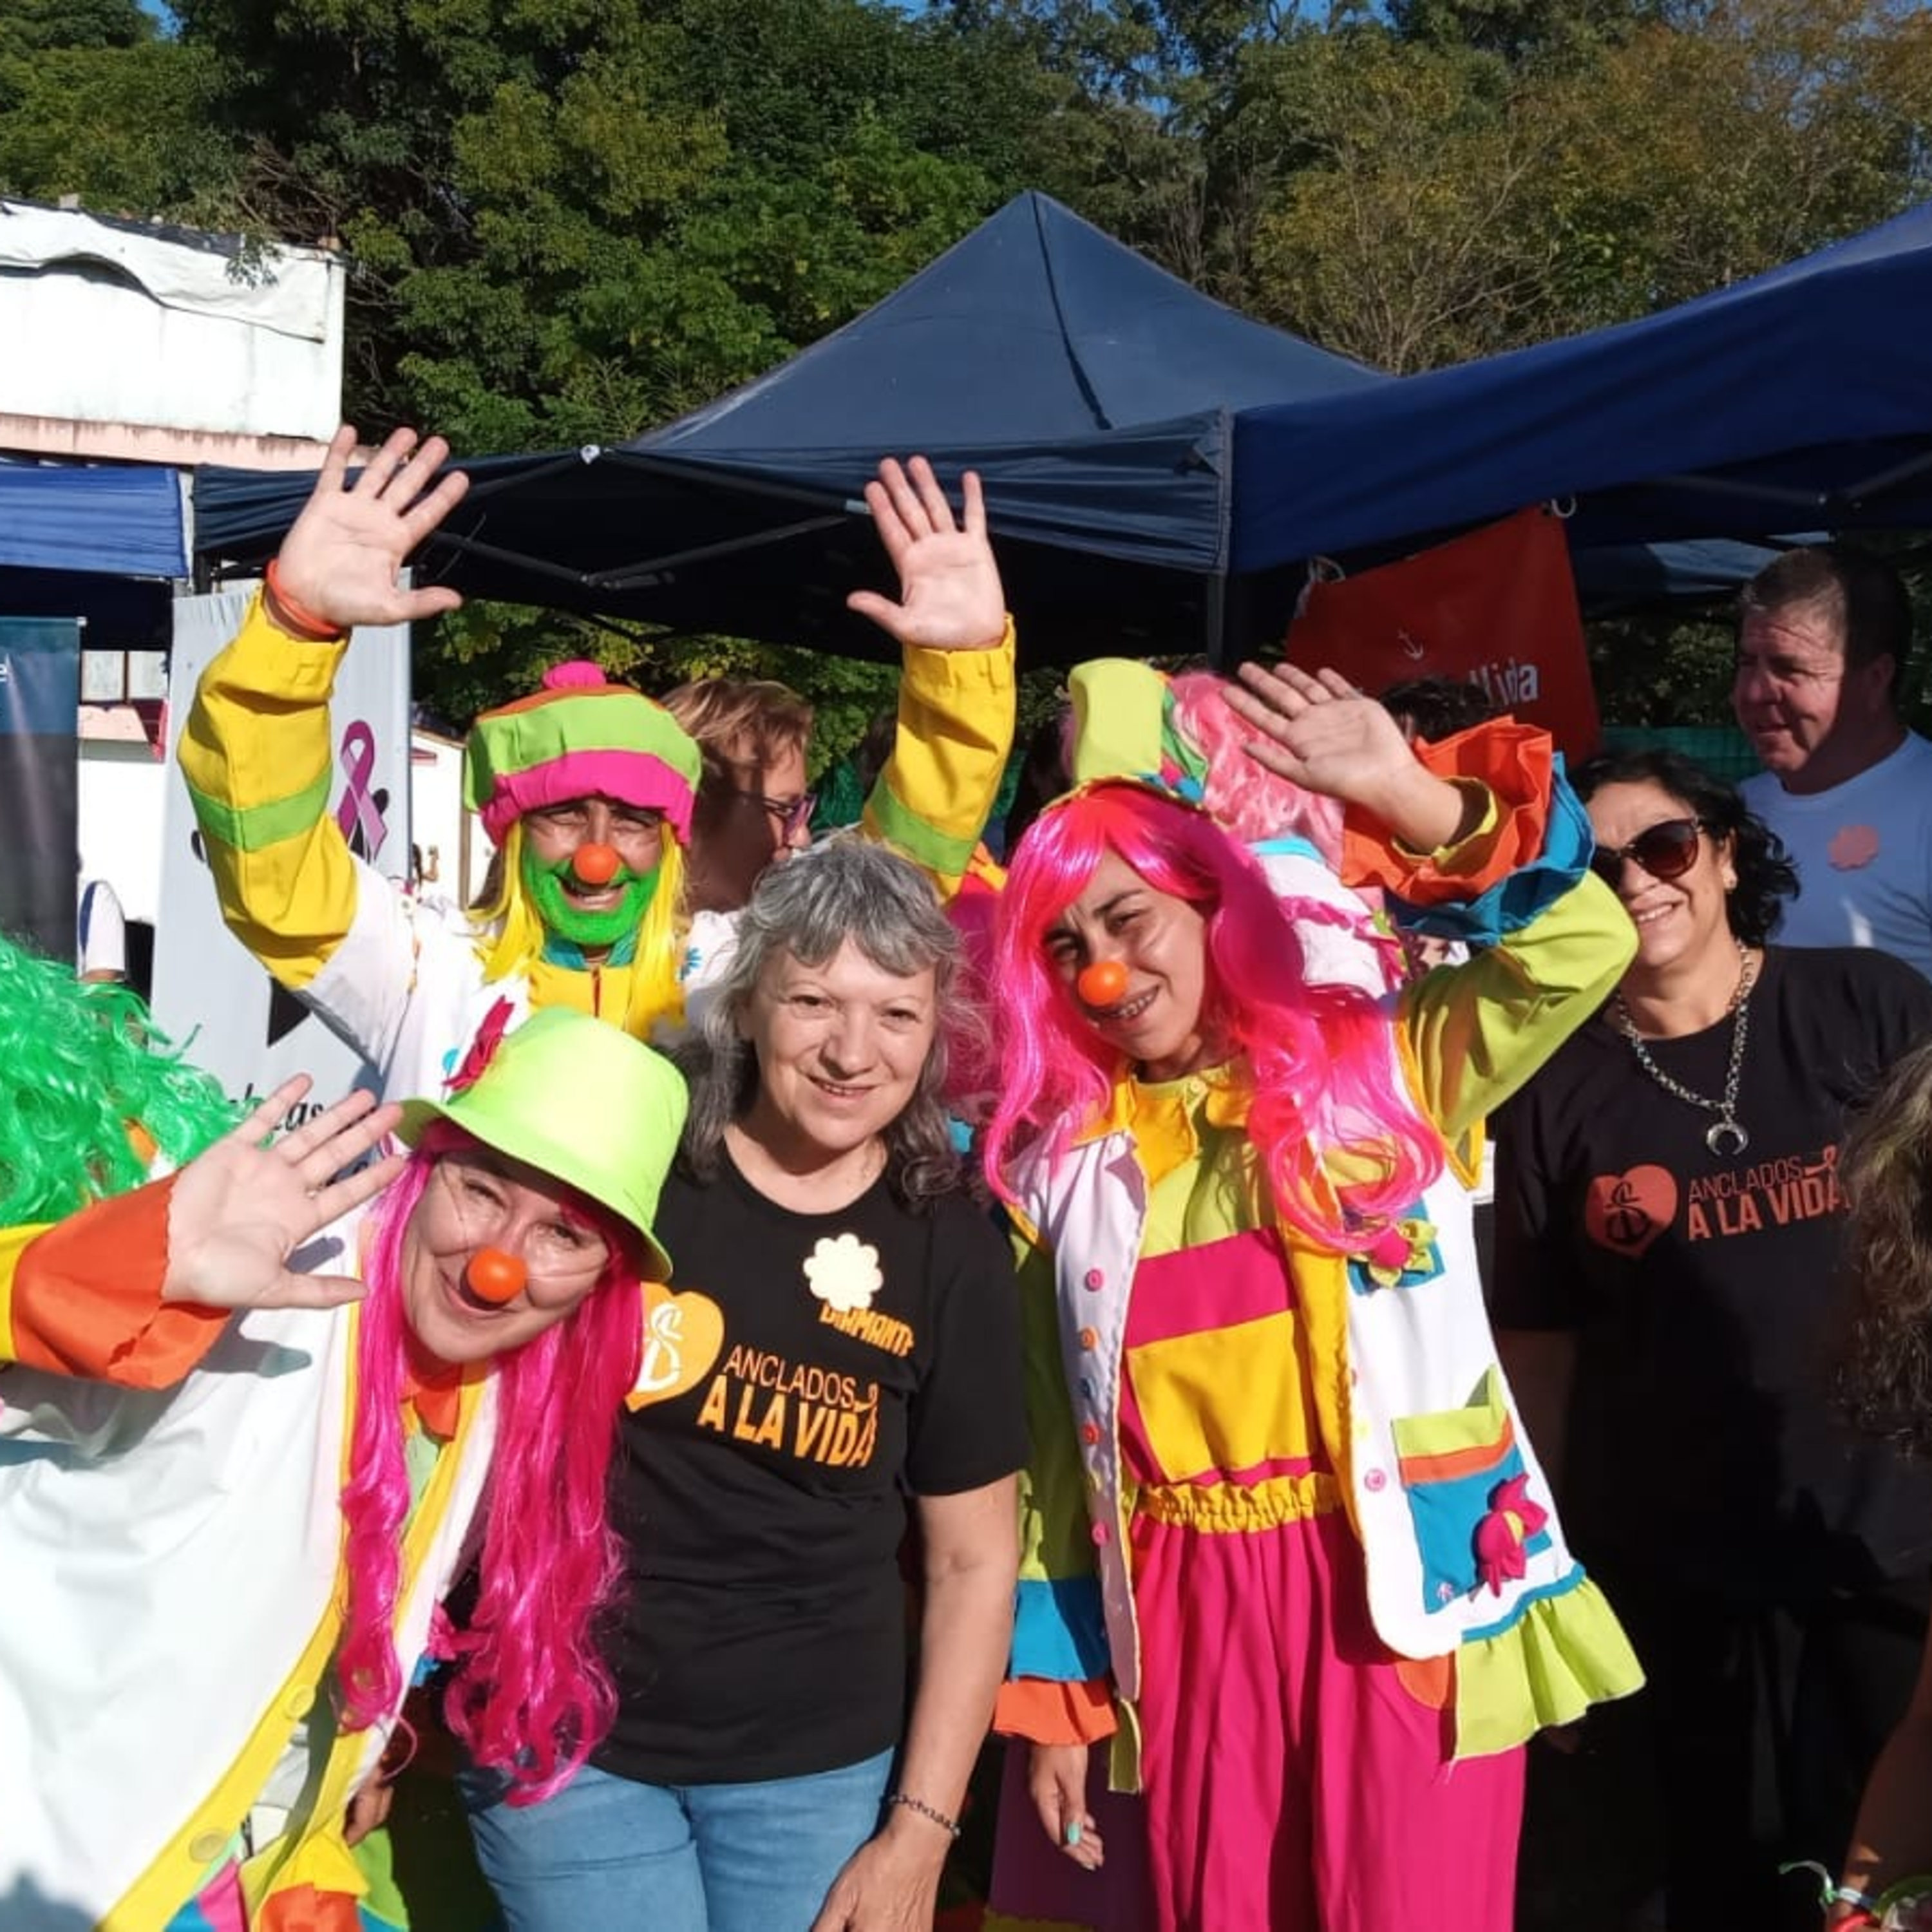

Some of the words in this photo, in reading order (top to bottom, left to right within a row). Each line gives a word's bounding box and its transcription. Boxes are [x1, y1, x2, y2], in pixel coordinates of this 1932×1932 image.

[1689, 1157, 1803, 1202] ANCLADOS
[1689, 1203, 1712, 1241] A
[1717, 1193, 1763, 1235] LA
[723, 1345, 857, 1408] ANCLADOS
[696, 1375, 727, 1432] A
[734, 1384, 786, 1450] LA
[794, 1401, 877, 1467] VIDA
